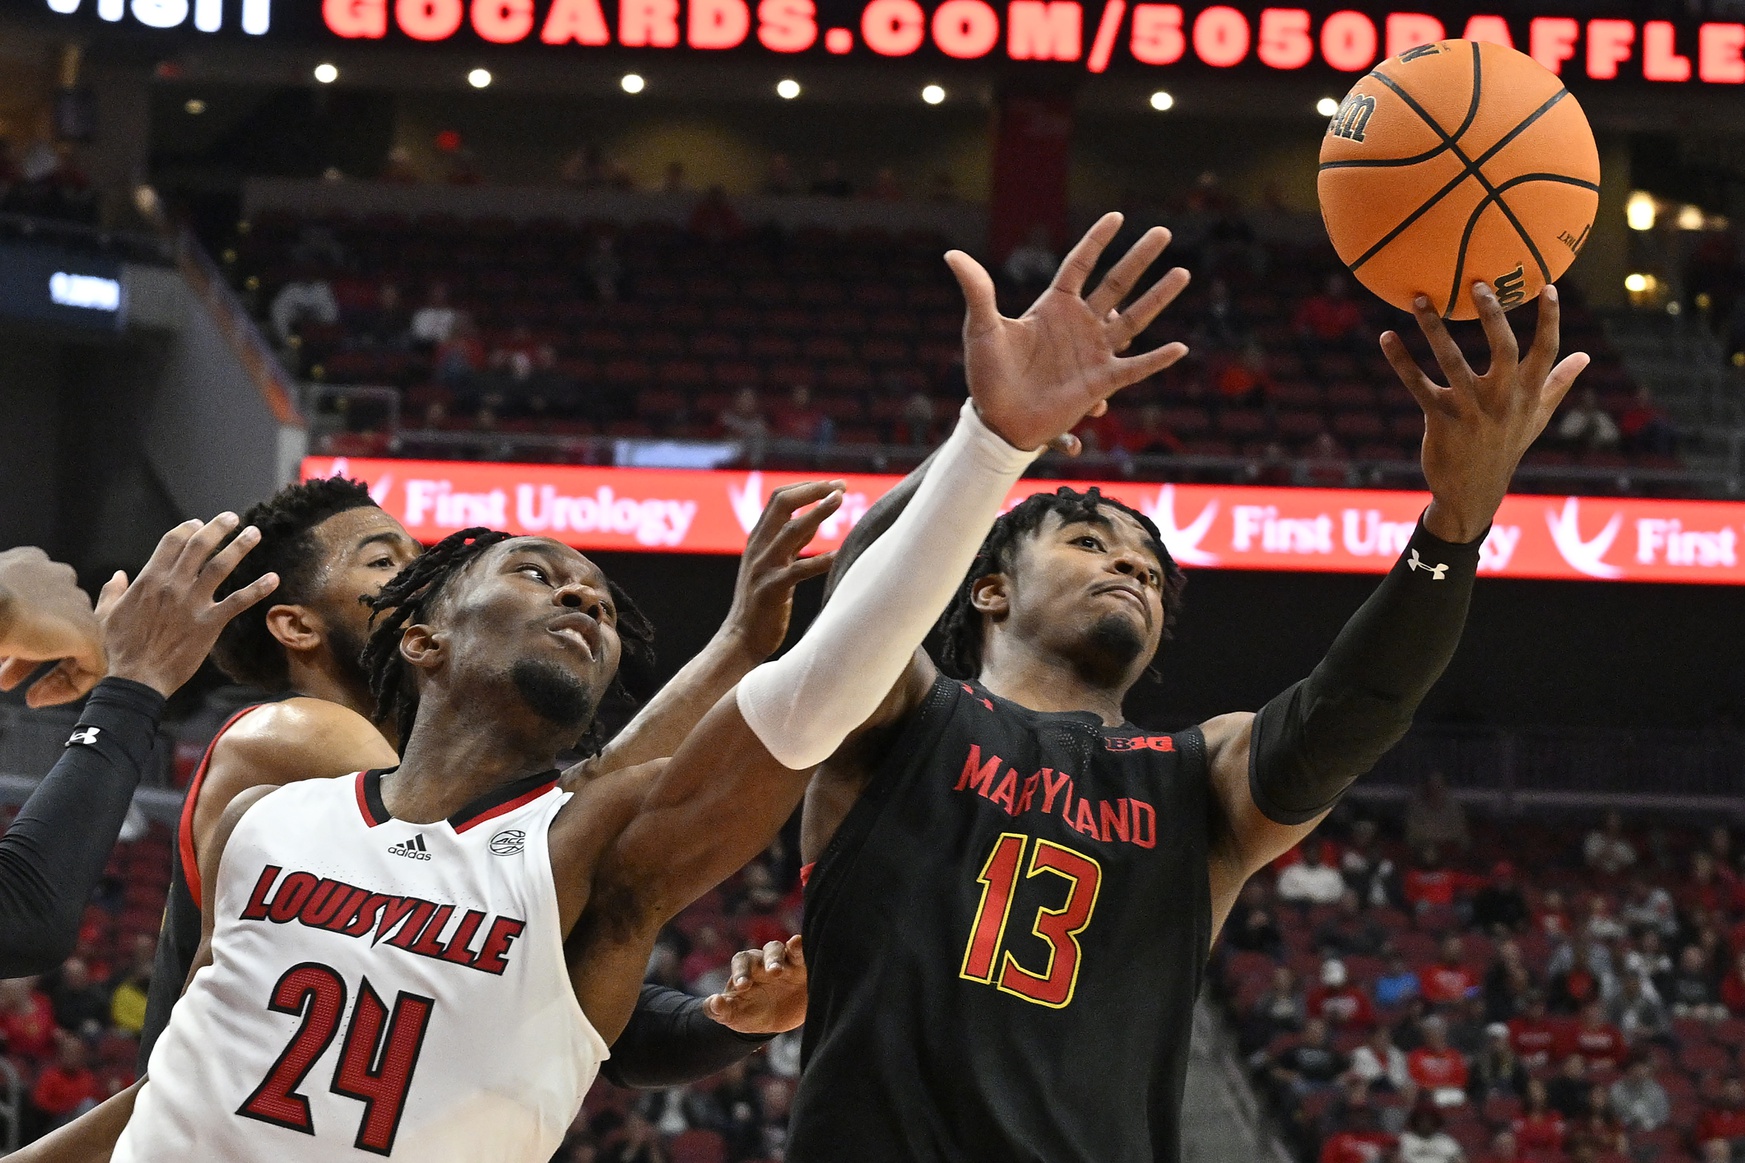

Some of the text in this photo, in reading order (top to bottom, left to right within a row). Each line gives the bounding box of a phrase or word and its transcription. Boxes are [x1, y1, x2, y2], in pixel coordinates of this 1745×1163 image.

[405, 479, 696, 546] First Urology
[1232, 505, 1332, 552] First
[1636, 518, 1737, 567] First
[953, 744, 1156, 849] MARYLAND
[387, 846, 432, 861] adidas
[239, 864, 527, 976] LOUISVILLE
[959, 832, 1102, 1009] 13
[235, 961, 435, 1157] 24
